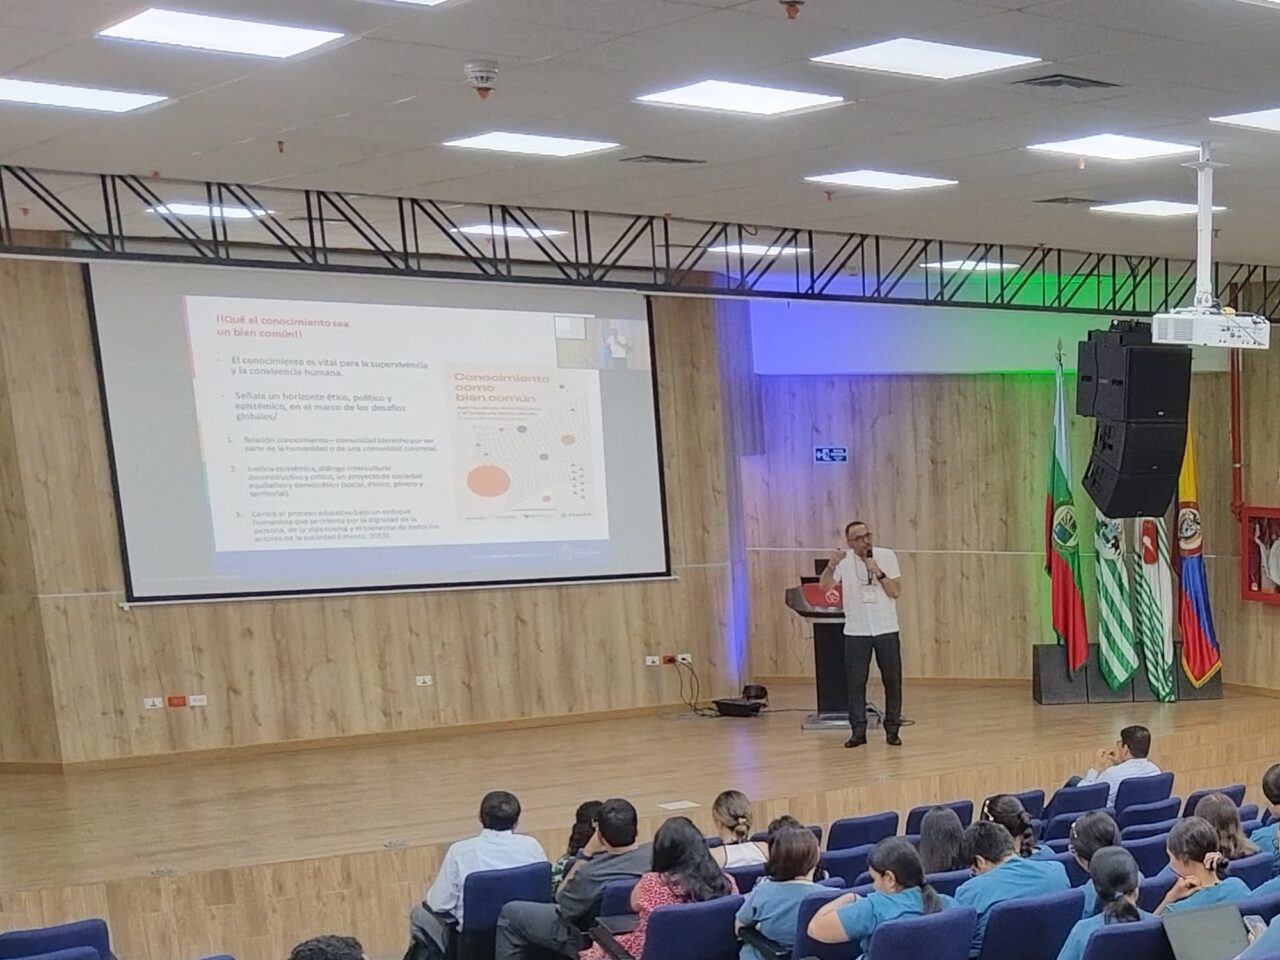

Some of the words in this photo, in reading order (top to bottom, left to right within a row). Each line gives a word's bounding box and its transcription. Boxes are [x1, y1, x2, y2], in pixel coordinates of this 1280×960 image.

[248, 315, 258, 325] el
[261, 316, 331, 327] conocimiento
[333, 319, 350, 328] sea
[233, 328, 257, 337] bien
[454, 372, 550, 383] Conocimiento
[455, 384, 495, 392] como
[455, 392, 486, 402] bien
